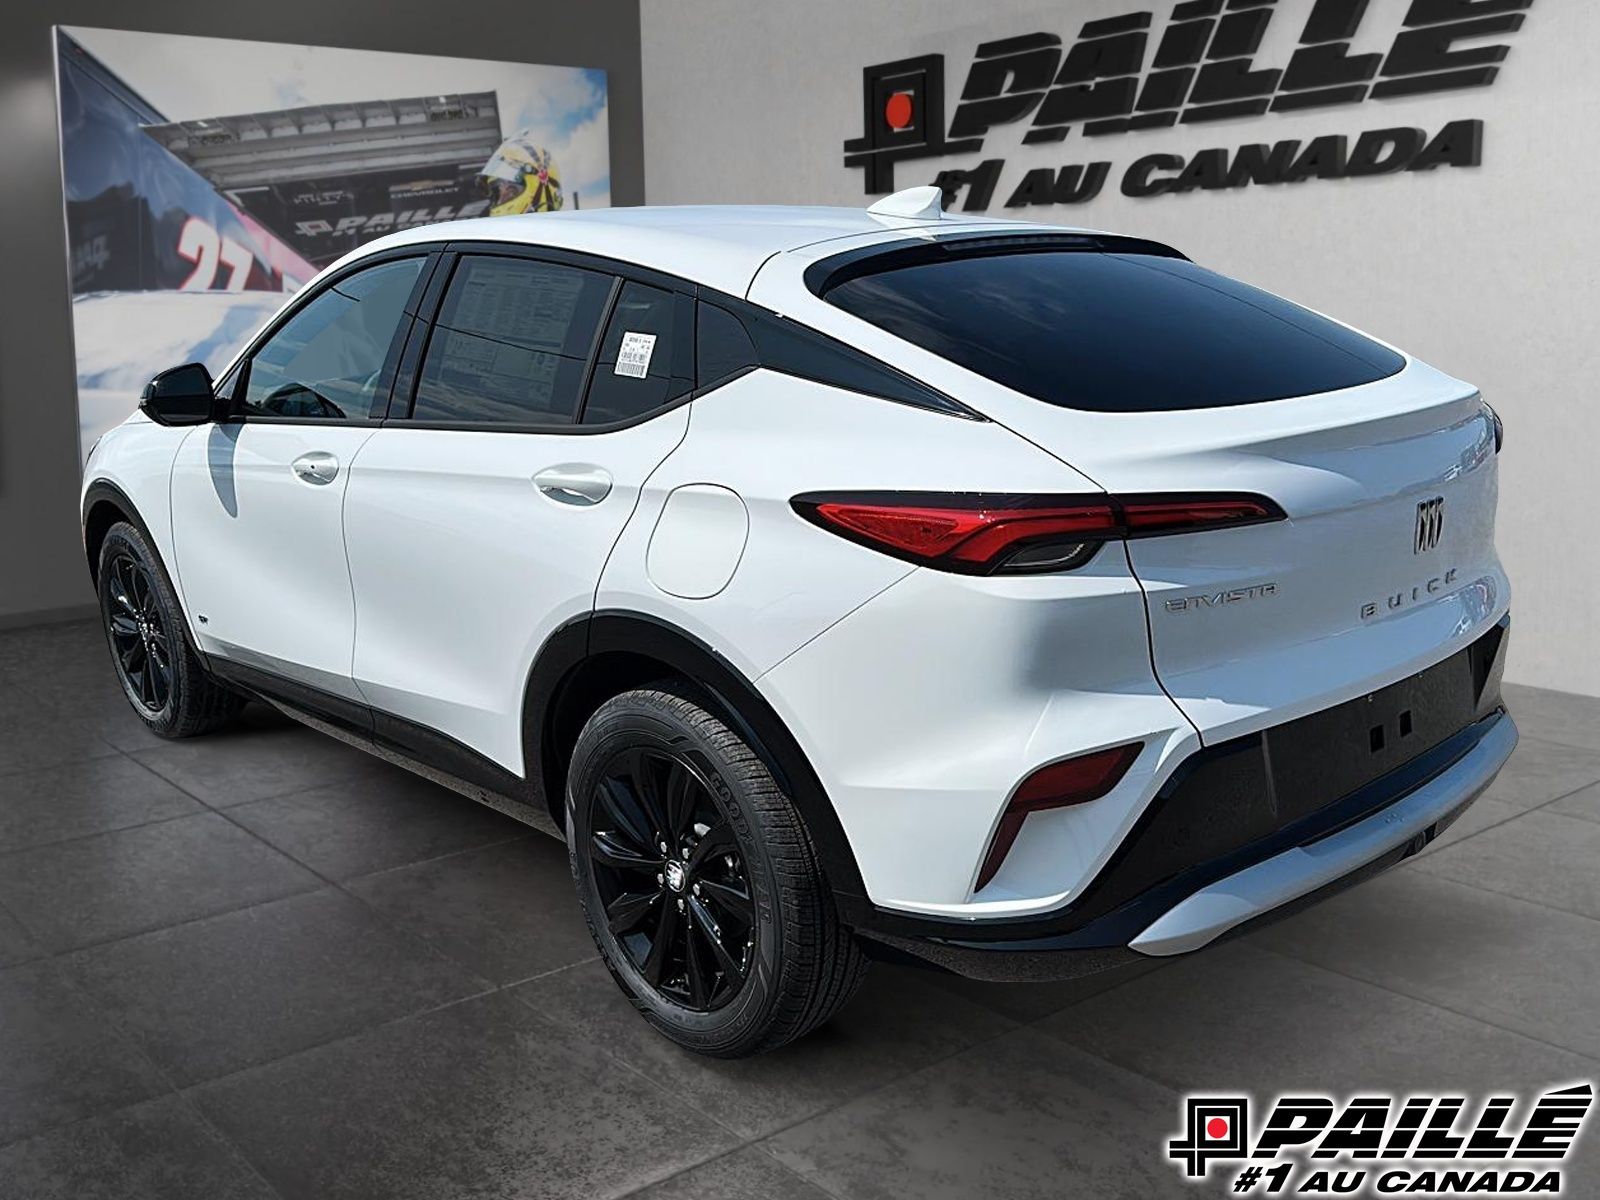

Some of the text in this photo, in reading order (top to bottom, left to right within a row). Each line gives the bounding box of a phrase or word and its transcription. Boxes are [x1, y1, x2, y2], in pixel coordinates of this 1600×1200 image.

[1005, 161, 1112, 209] AU
[1120, 119, 1484, 198] CANADA
[175, 216, 255, 291] 27
[1164, 582, 1279, 614] ENVISTA
[1360, 567, 1459, 620] BUICK
